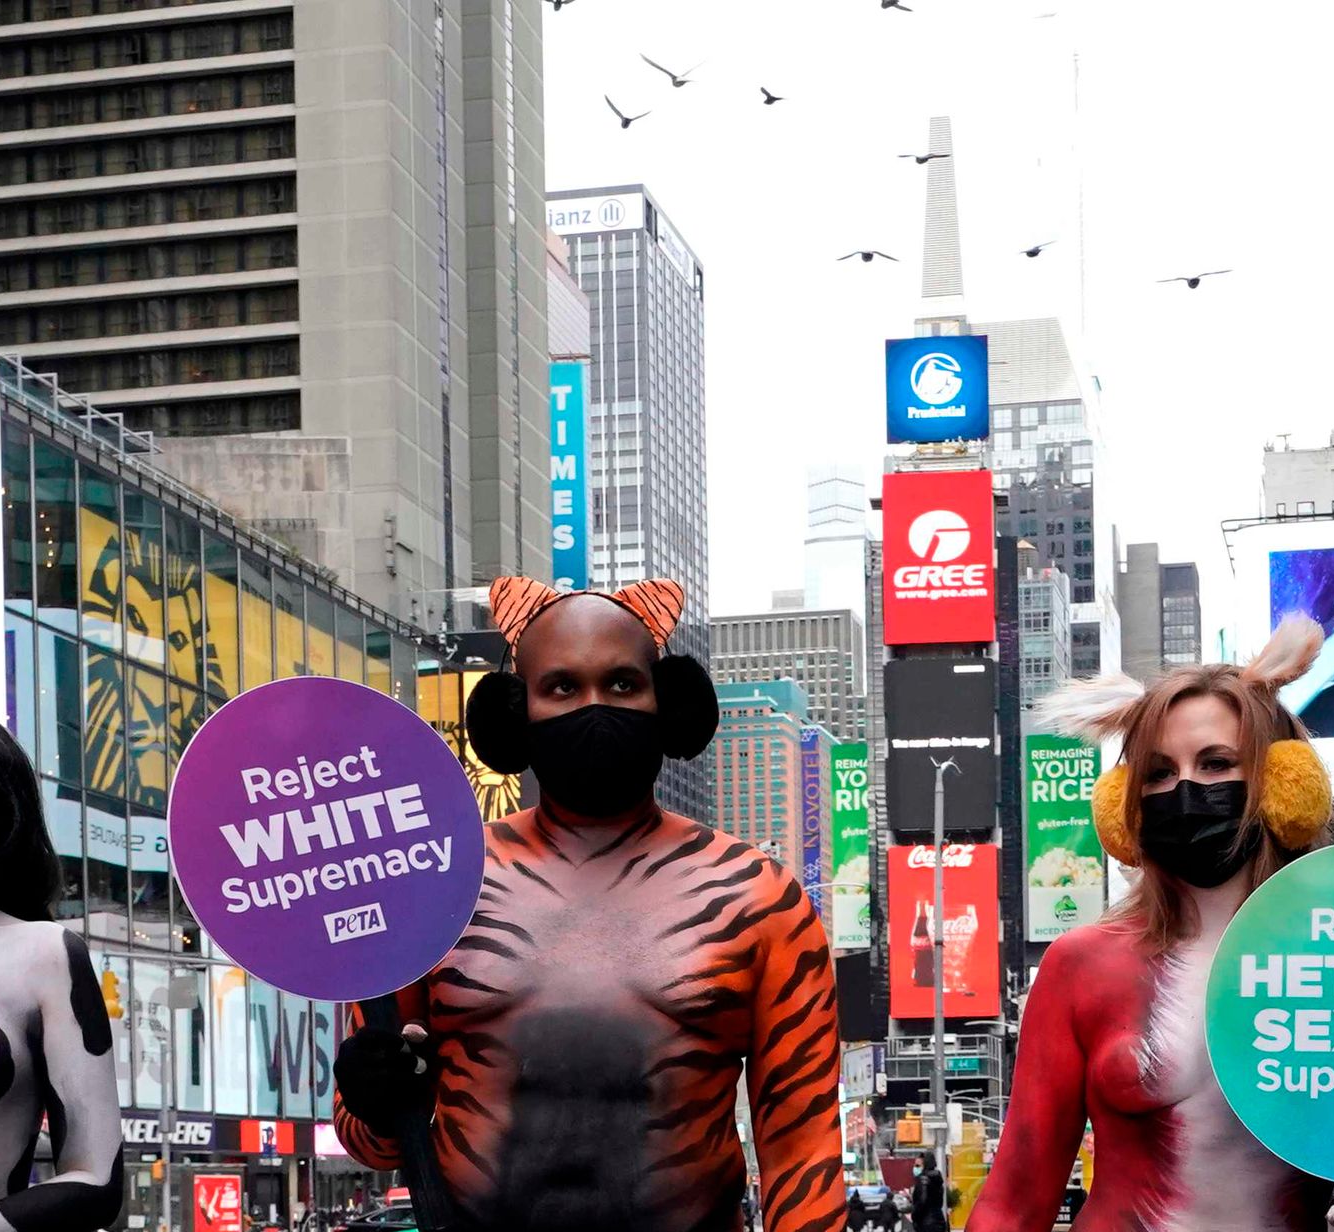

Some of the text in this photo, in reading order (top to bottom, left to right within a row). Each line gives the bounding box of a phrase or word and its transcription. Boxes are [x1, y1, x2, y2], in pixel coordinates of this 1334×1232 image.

[907, 405, 966, 418] Prudential
[551, 385, 576, 550] TIMES
[893, 564, 987, 588] GREE
[895, 588, 988, 600] www.gree.com
[1031, 747, 1094, 759] REIMAGINE
[241, 745, 381, 804] Reject
[1032, 759, 1094, 779] YOUR
[802, 744, 819, 849] NOVOTEL
[1032, 778, 1095, 802] RICE
[219, 783, 430, 868] WHITE
[1037, 816, 1090, 830] gluten-free
[221, 836, 452, 914] Supremacy
